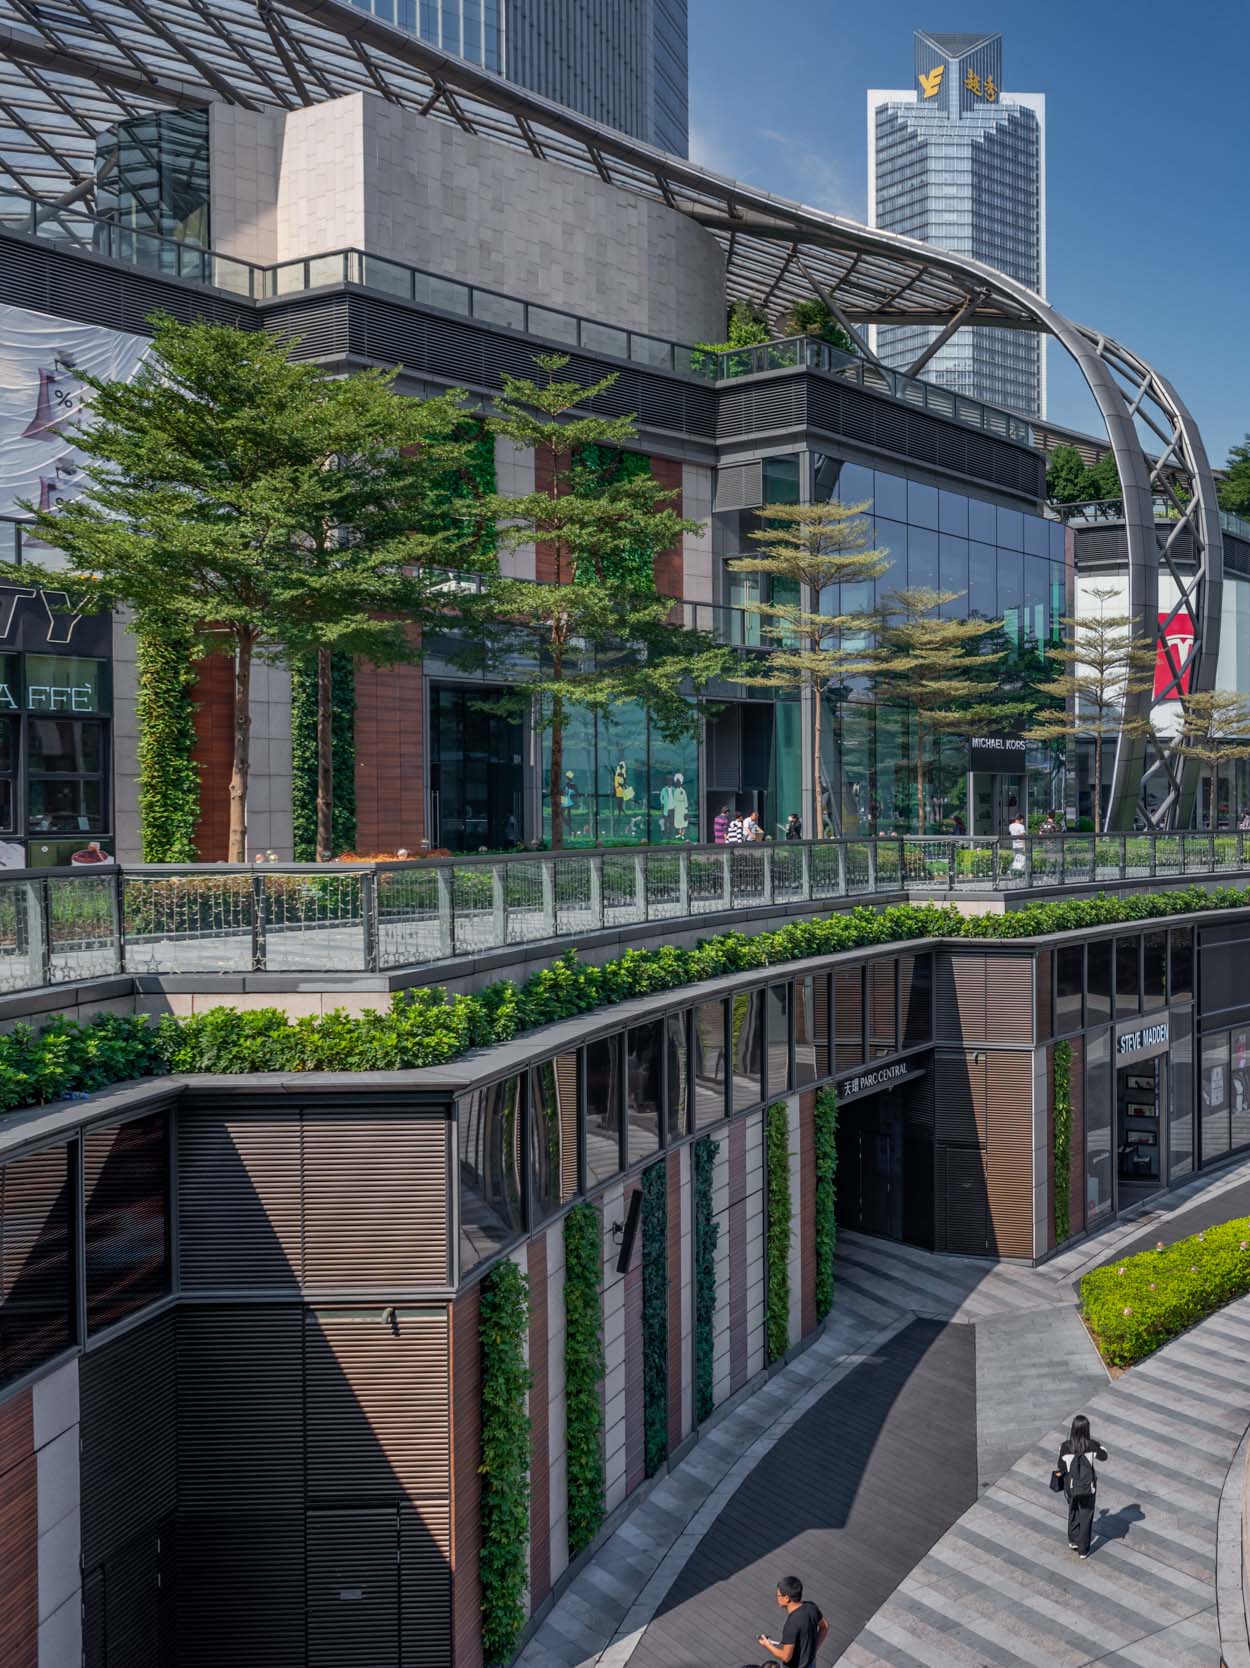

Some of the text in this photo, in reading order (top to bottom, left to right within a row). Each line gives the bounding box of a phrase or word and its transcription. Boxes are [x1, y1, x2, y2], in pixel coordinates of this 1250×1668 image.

[972, 737, 1026, 751] MICHAEL KORS
[1120, 1023, 1169, 1054] STEVE MADDEN
[860, 1072, 878, 1089] PARC
[878, 1062, 908, 1082] CENTRAL
